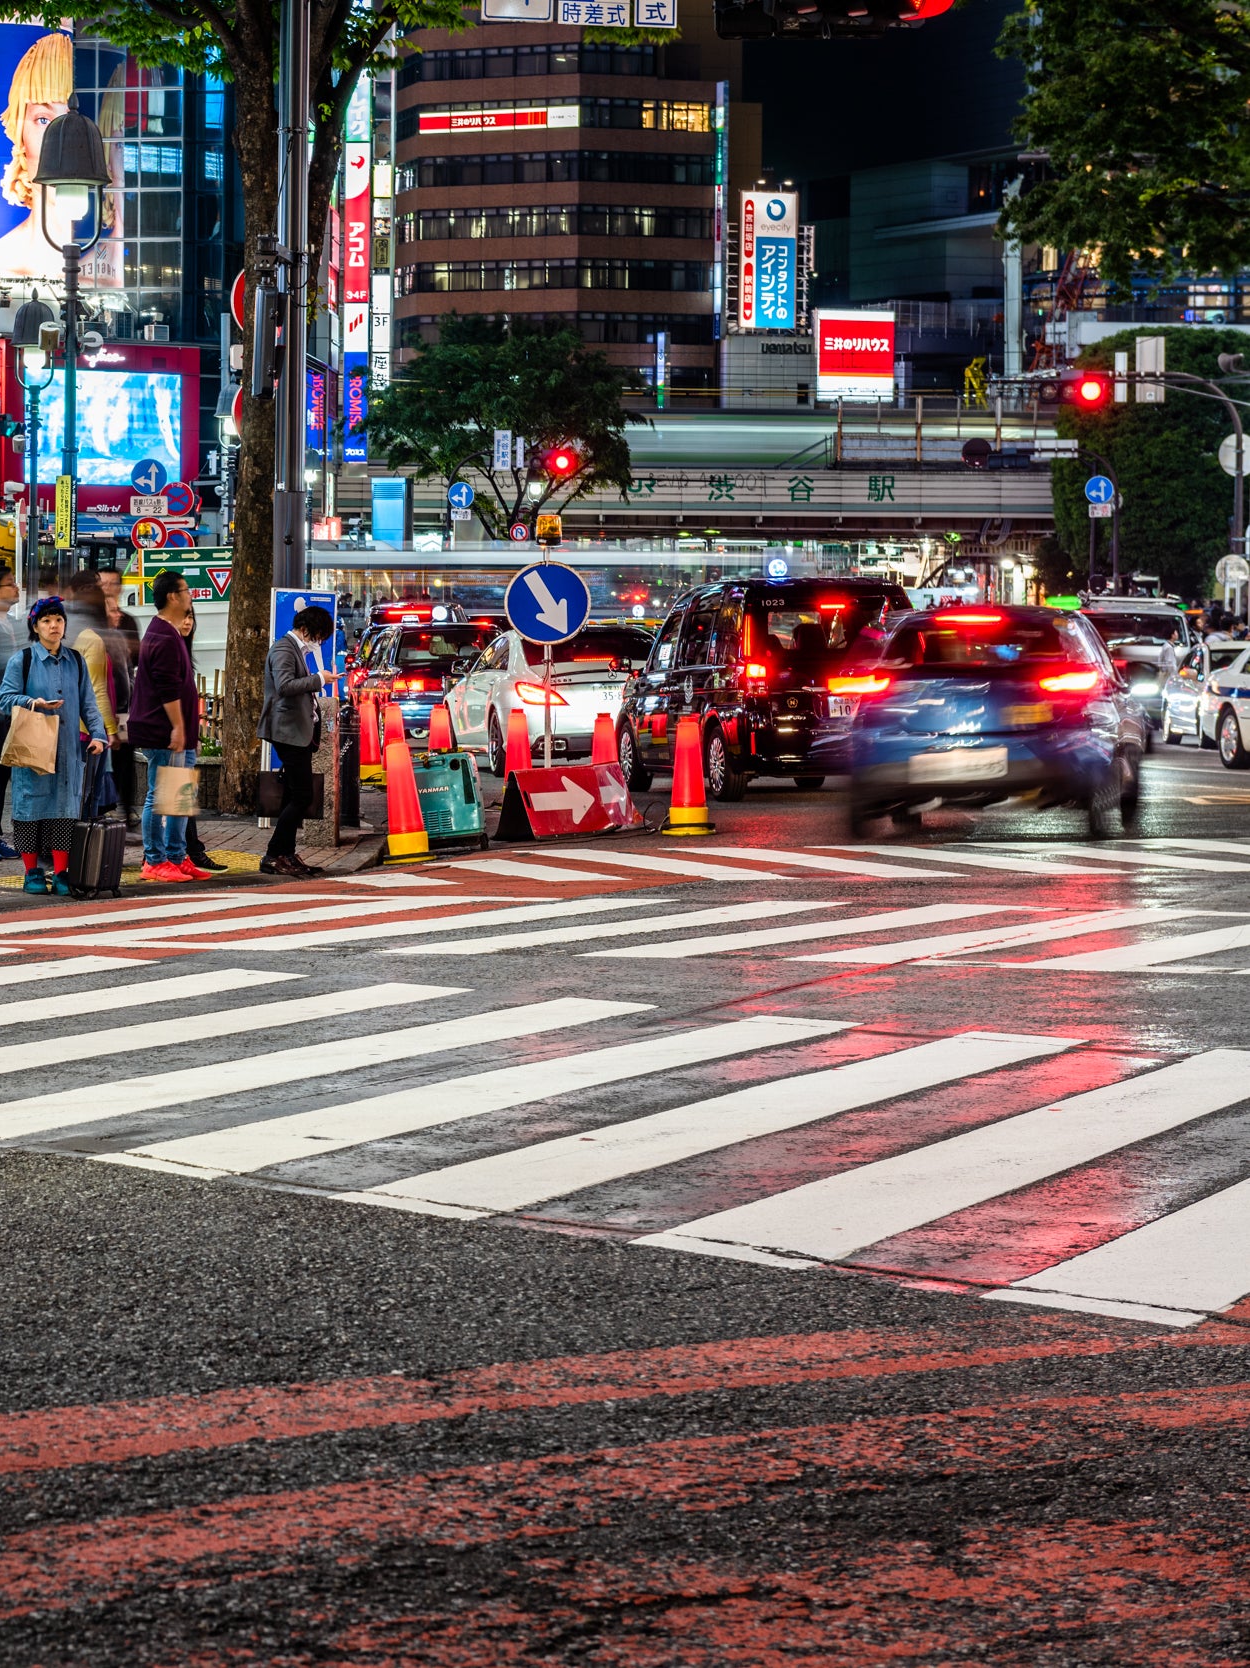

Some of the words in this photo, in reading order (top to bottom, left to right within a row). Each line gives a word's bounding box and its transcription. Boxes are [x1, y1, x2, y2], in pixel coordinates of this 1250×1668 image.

[562, 3, 625, 25] 時差式
[451, 117, 496, 126] 三井のリハウス
[760, 222, 791, 232] eyecity
[349, 222, 366, 267] アコム
[760, 244, 776, 319] アイシティ
[776, 245, 788, 320] コンタクトの
[374, 316, 388, 327] 3F
[823, 337, 890, 352] 三井のリハウス
[349, 371, 363, 431] ROMIS
[707, 474, 895, 502] 渋谷駅
[191, 588, 211, 599] 事中
[761, 599, 785, 607] 1023
[418, 785, 449, 794] YANMAR
